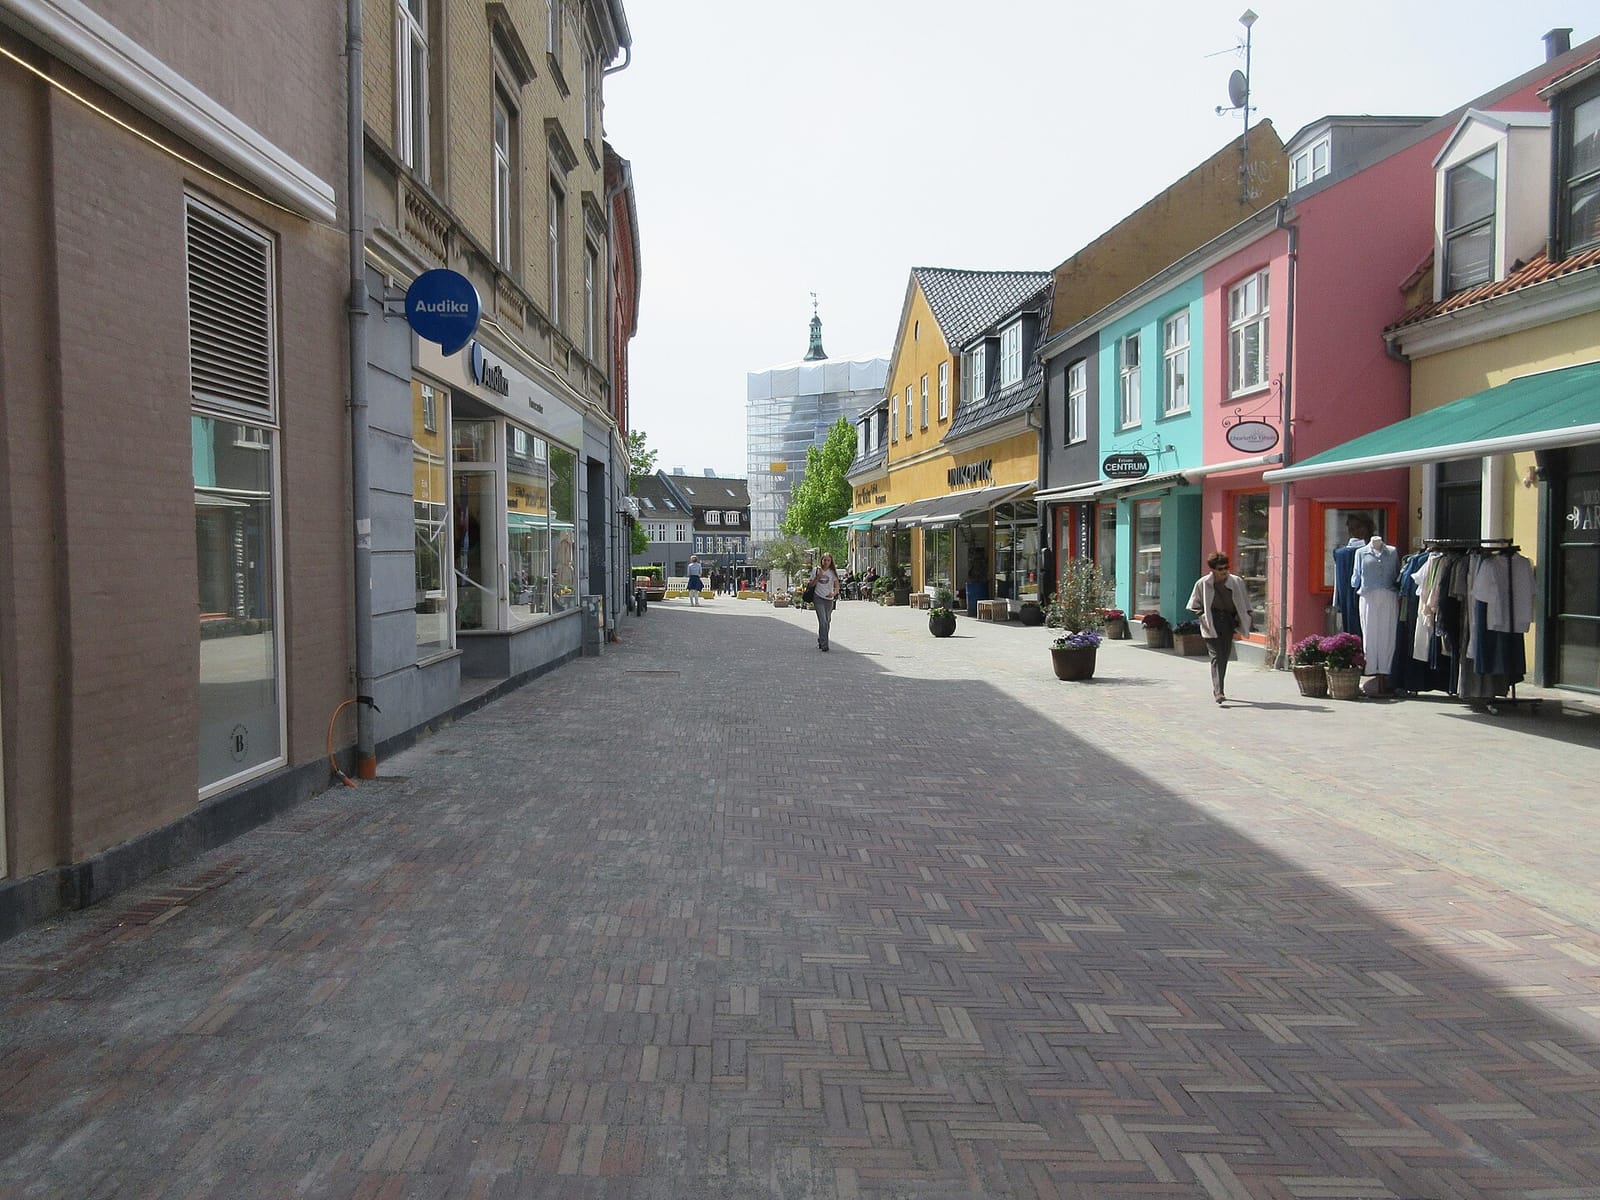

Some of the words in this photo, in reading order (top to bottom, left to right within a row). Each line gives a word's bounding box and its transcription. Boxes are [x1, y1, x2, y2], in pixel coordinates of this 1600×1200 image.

[415, 299, 469, 314] Audika
[482, 358, 509, 397] Audika
[1105, 462, 1148, 472] CENTRUM
